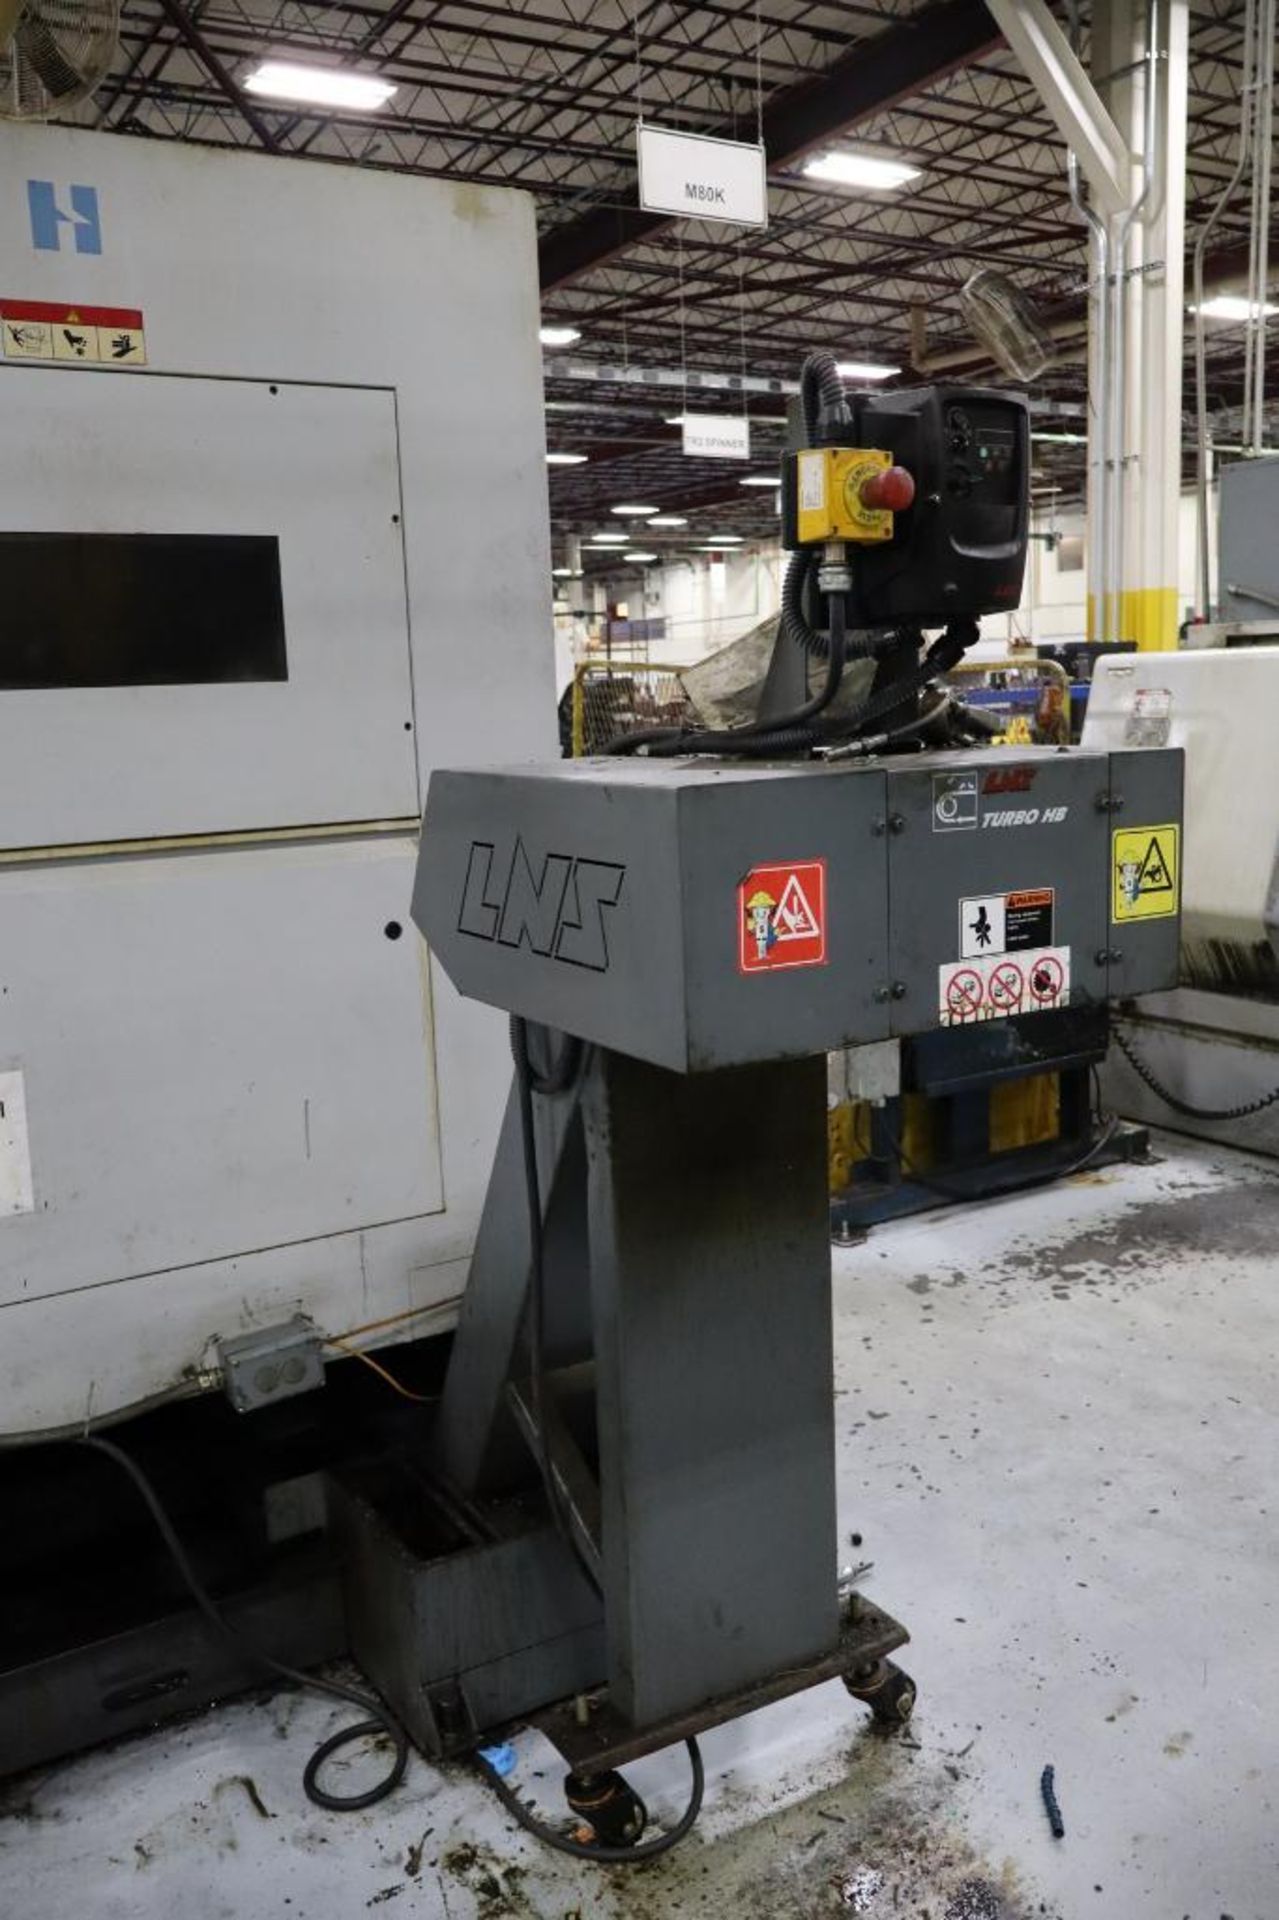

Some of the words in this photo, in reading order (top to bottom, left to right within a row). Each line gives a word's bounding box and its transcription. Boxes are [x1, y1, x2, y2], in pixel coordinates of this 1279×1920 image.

[684, 183, 726, 204] M80K
[981, 808, 1040, 829] TURBO
[1041, 806, 1068, 823] HB
[457, 834, 626, 972] LNS
